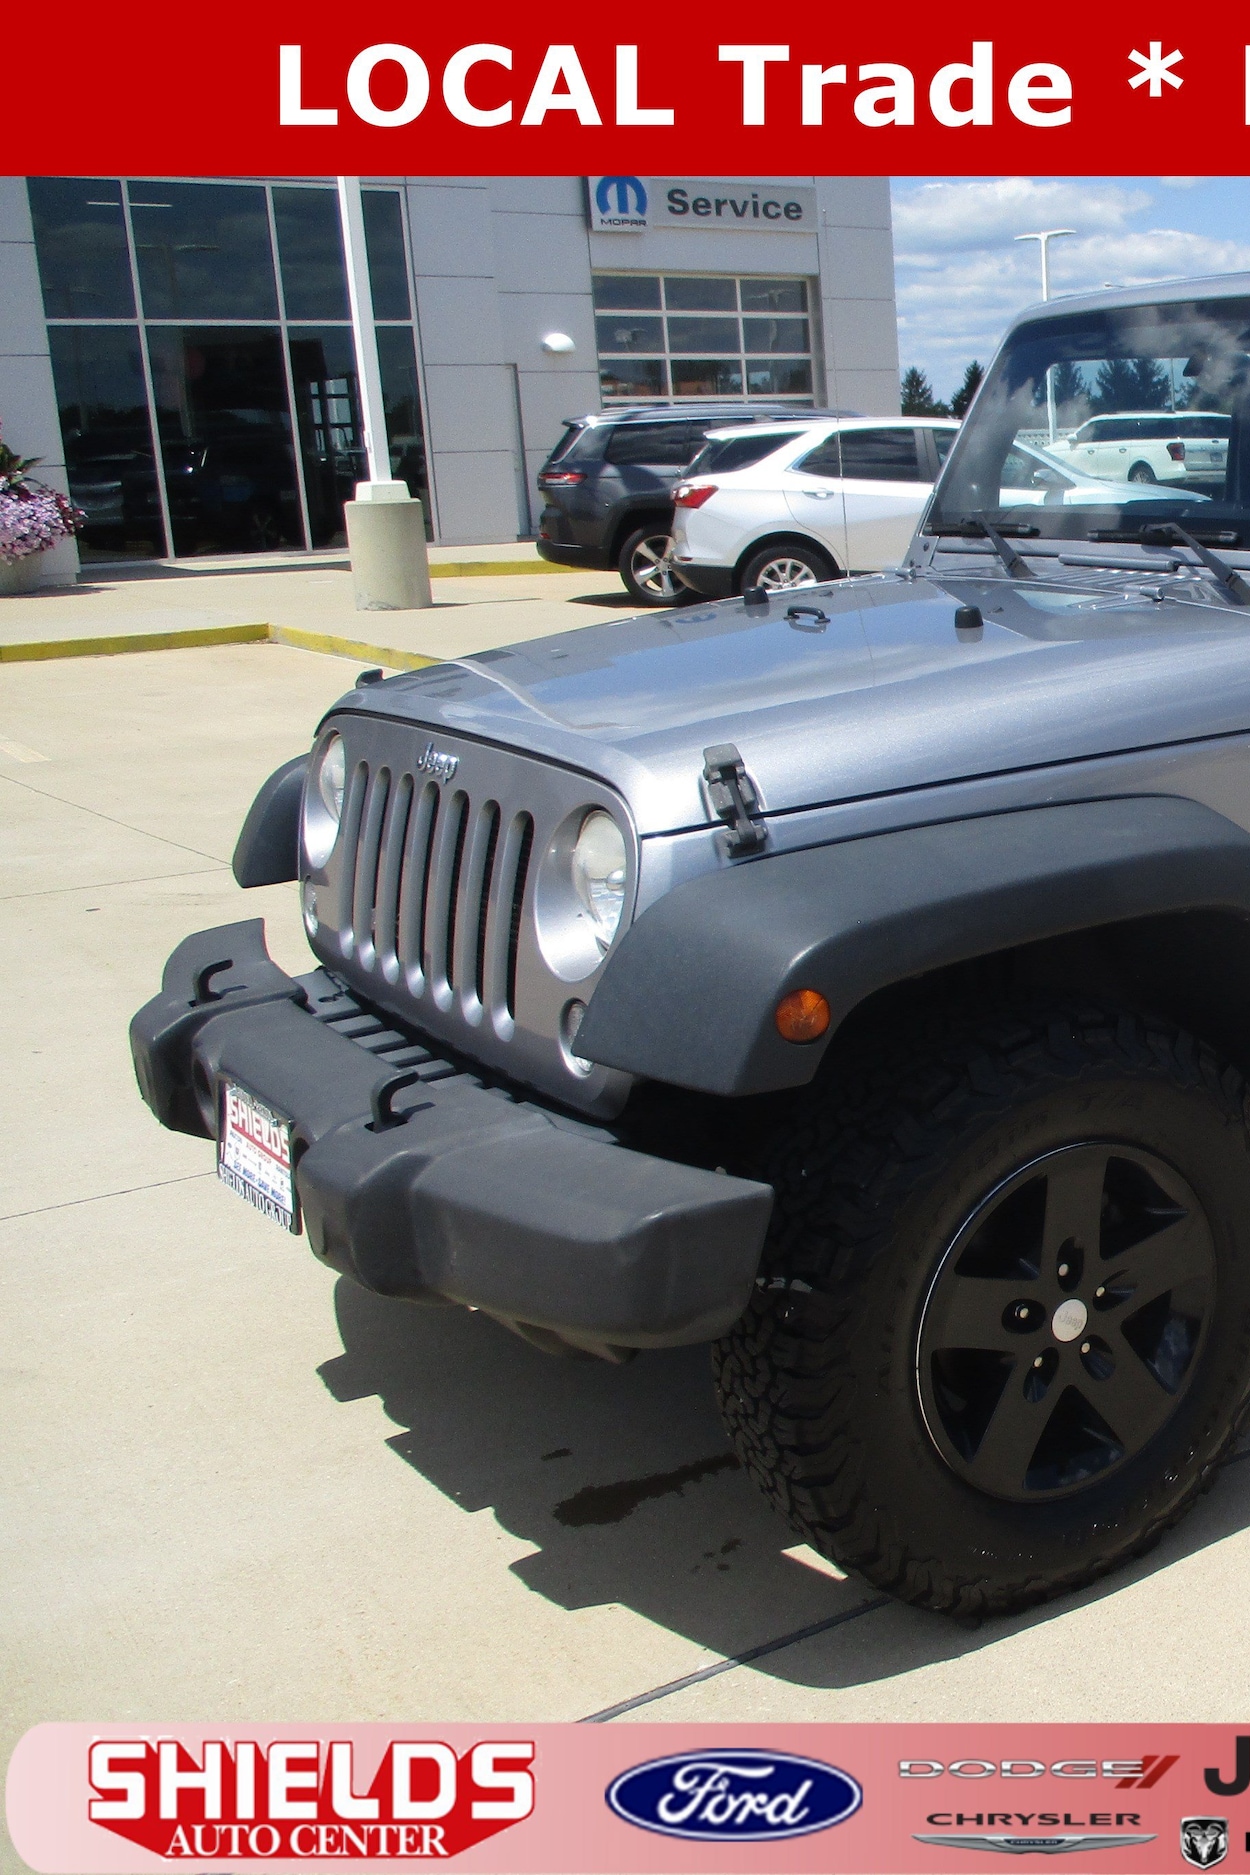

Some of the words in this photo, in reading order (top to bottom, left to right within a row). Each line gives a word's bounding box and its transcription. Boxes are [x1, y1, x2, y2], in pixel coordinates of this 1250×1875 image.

[601, 217, 647, 227] MOPAR
[667, 188, 803, 221] Service
[417, 741, 460, 785] Jeep
[229, 1095, 290, 1165] SHIELDS
[219, 1164, 245, 1199] SHIELDS
[244, 1183, 265, 1214] AUTO
